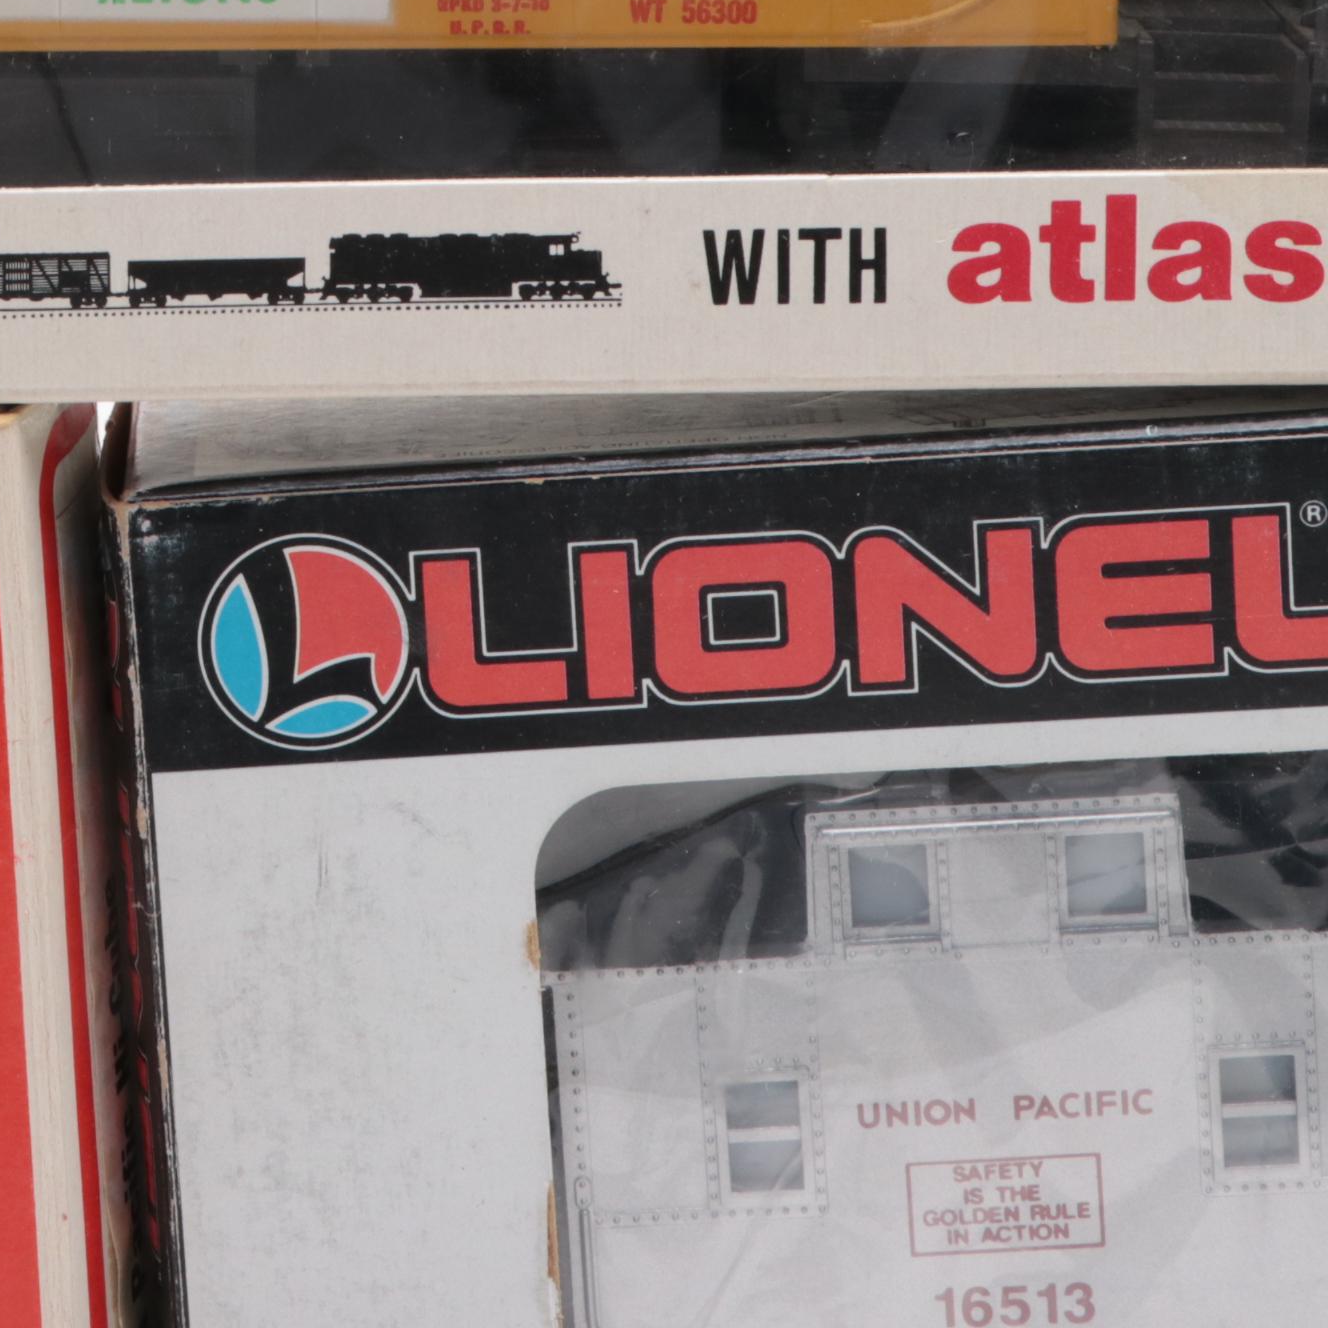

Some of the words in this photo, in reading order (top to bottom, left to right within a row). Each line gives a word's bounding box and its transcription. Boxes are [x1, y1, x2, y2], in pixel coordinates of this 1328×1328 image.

[681, 0, 758, 24] 56300
[703, 227, 888, 306] WITH
[946, 194, 1325, 303] atlas
[420, 508, 1328, 708] LIONEL
[857, 1097, 976, 1129] UNION
[1013, 1088, 1153, 1120] PACIFIC
[953, 1161, 1043, 1183] SAFETY
[963, 1187, 984, 1205] IS
[996, 1185, 1041, 1203] THE
[923, 1206, 1020, 1227] GOLDEN
[1030, 1202, 1091, 1221] RULE
[947, 1228, 969, 1245] IN
[982, 1223, 1070, 1243] ACTION
[934, 1282, 1095, 1328] 16513
